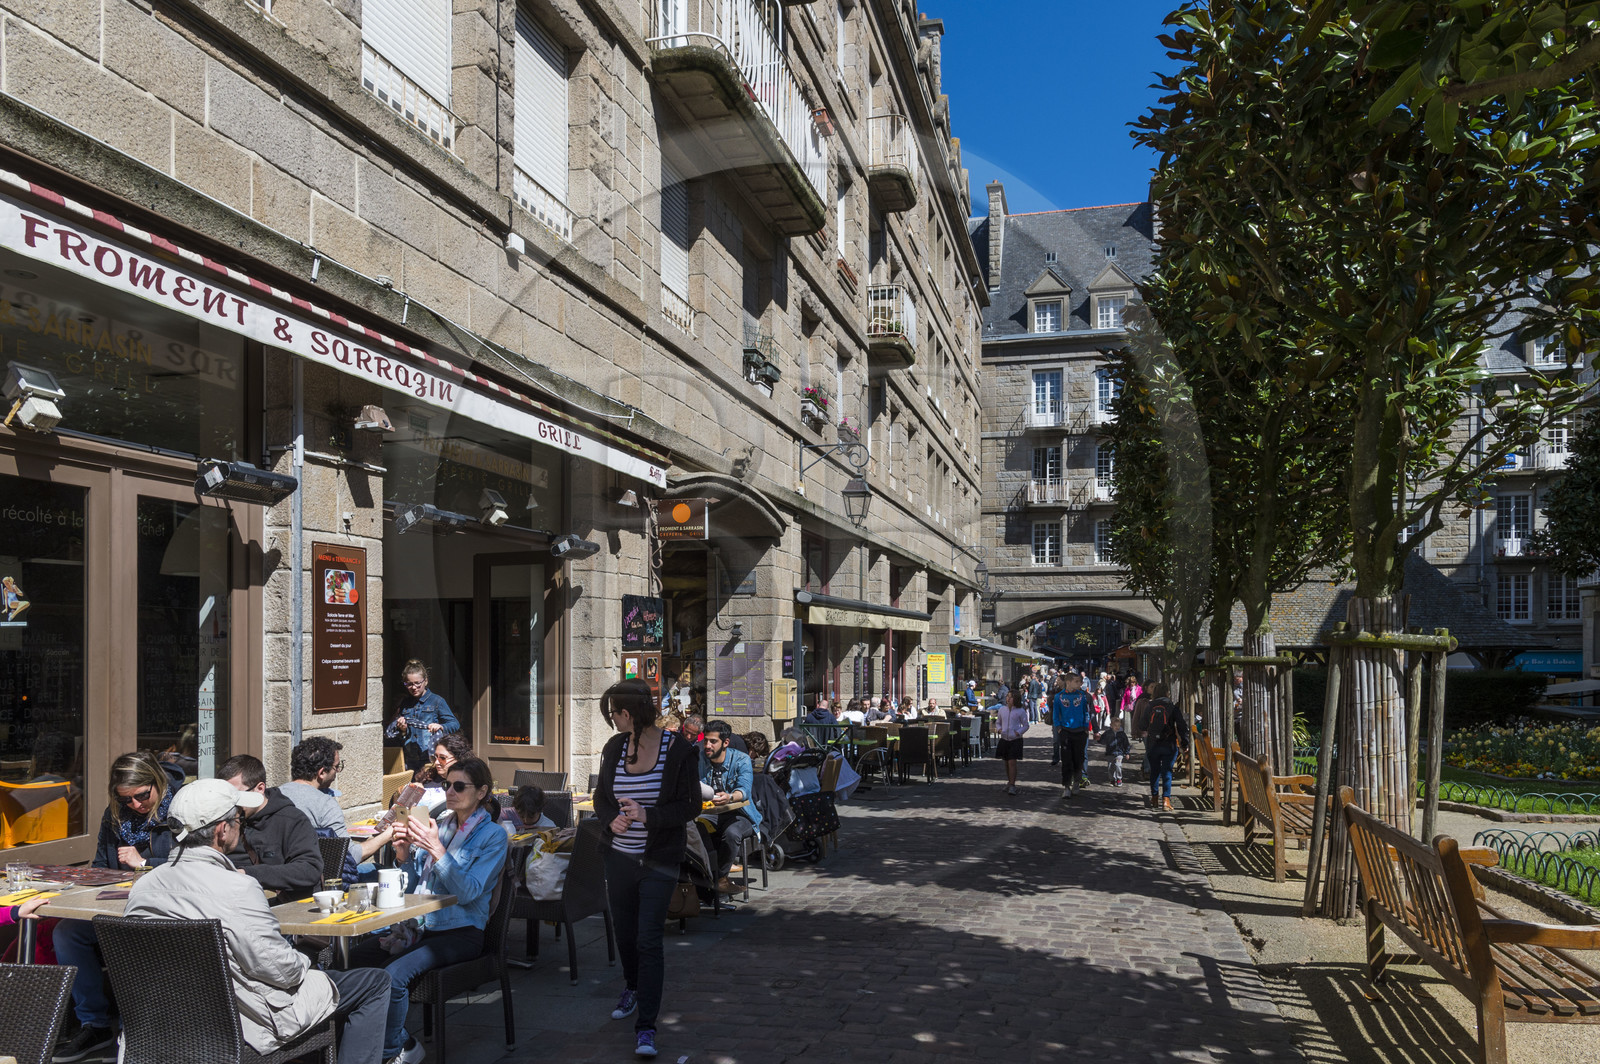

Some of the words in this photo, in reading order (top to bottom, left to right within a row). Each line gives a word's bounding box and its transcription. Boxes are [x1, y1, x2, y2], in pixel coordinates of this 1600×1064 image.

[20, 213, 249, 325] FROMENT
[273, 316, 293, 343] &
[28, 307, 152, 366] SARRASIN
[66, 354, 154, 394] GRILL
[538, 421, 582, 450] GRILL
[2, 504, 52, 524] récolté
[58, 510, 66, 526] à
